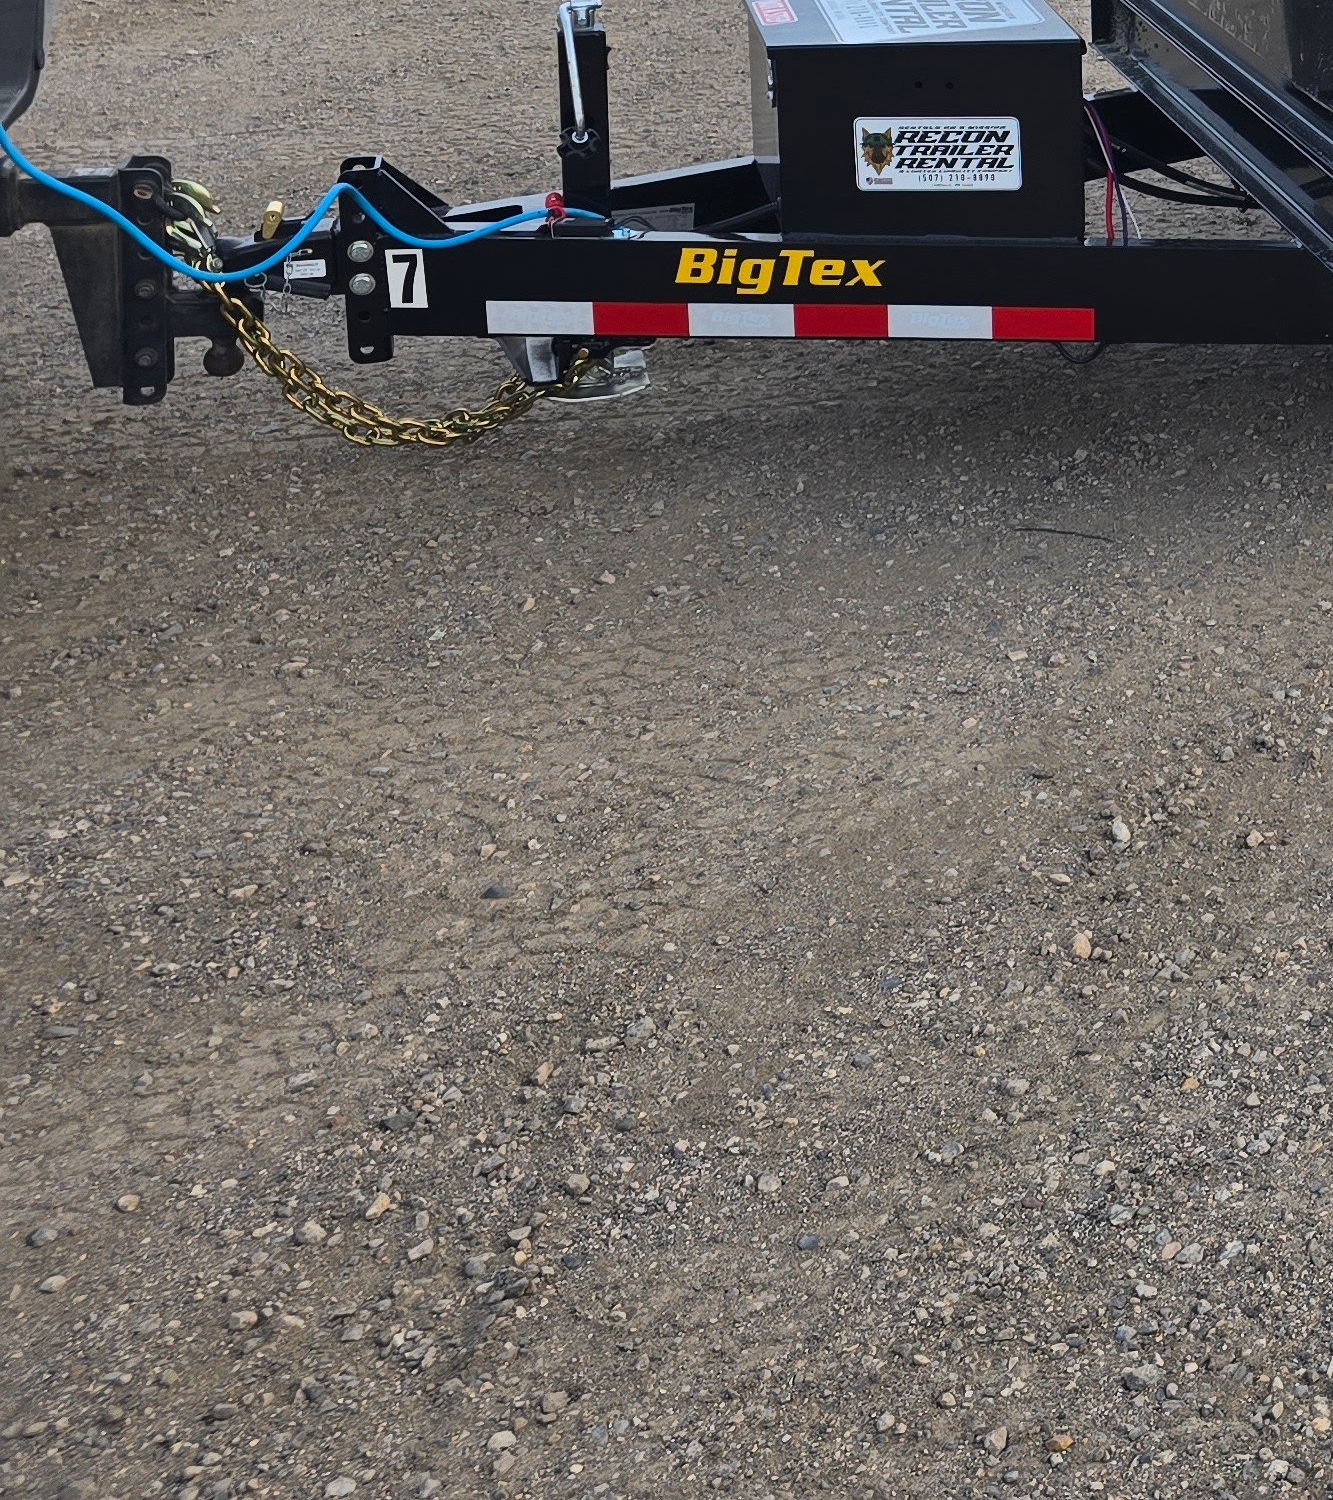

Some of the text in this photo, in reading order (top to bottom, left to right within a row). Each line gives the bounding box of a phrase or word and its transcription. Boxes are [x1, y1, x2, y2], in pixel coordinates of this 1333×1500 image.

[895, 130, 1011, 144] RECON
[895, 144, 1015, 157] TRAILER
[895, 157, 1015, 169] RENTAL
[674, 247, 886, 295] BigTex
[391, 254, 417, 304] 7
